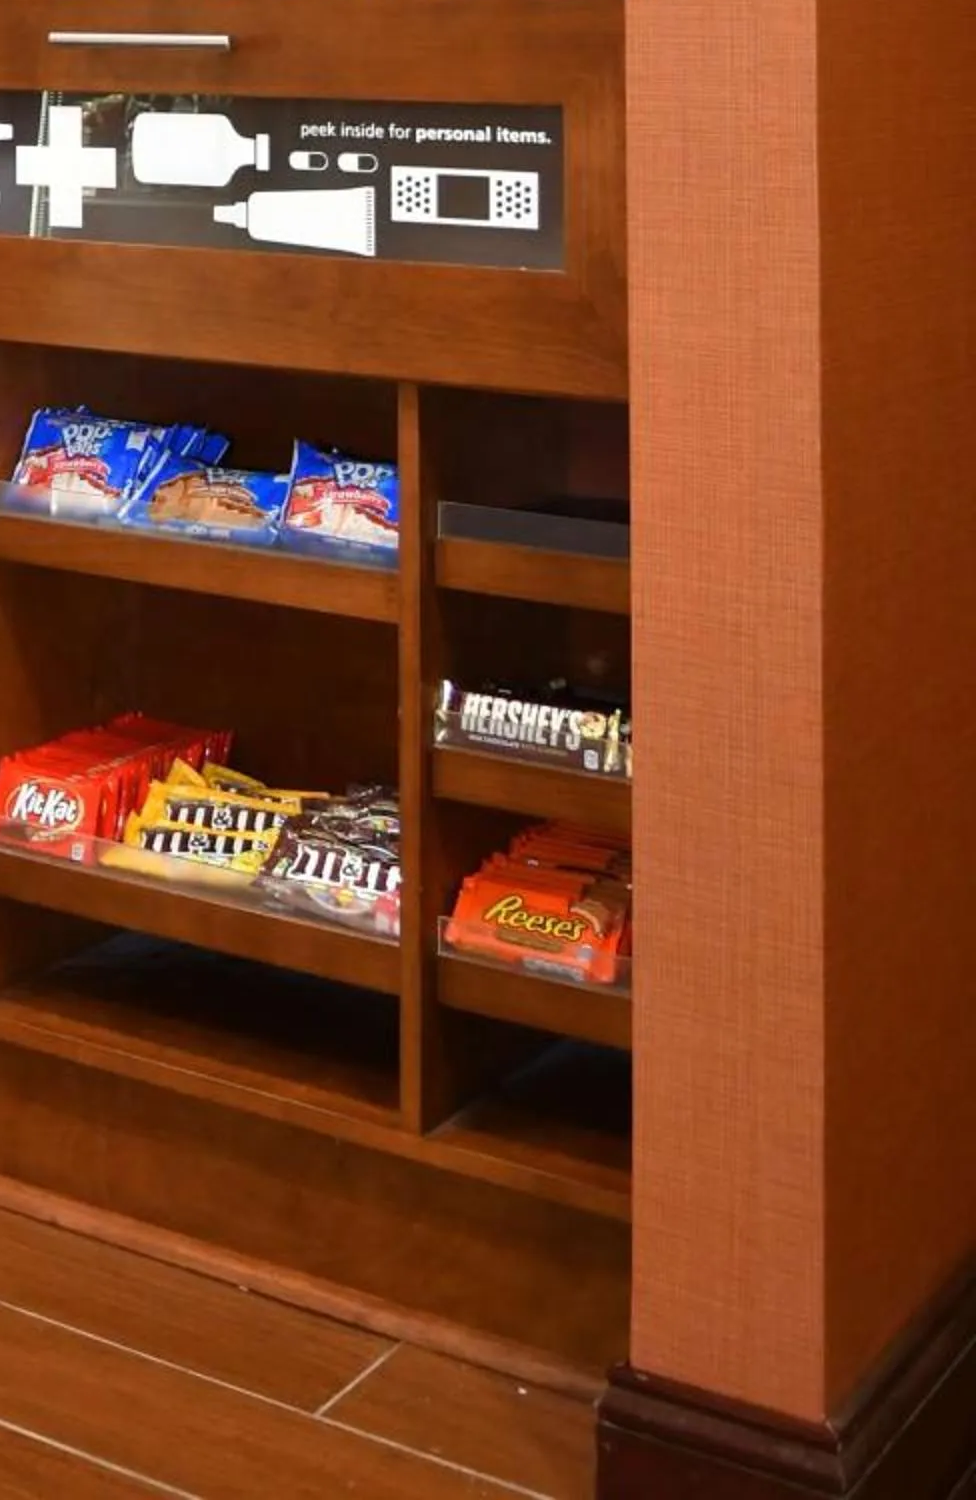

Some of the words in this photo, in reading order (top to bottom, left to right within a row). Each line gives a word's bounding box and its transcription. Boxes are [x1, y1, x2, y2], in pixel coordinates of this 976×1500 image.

[300, 121, 337, 138] peek
[340, 122, 385, 139] inside
[388, 122, 412, 139] for
[415, 125, 491, 144] personal
[496, 127, 552, 145] items.
[461, 692, 584, 751] HERSHEY'S
[485, 895, 586, 941] Reese's
